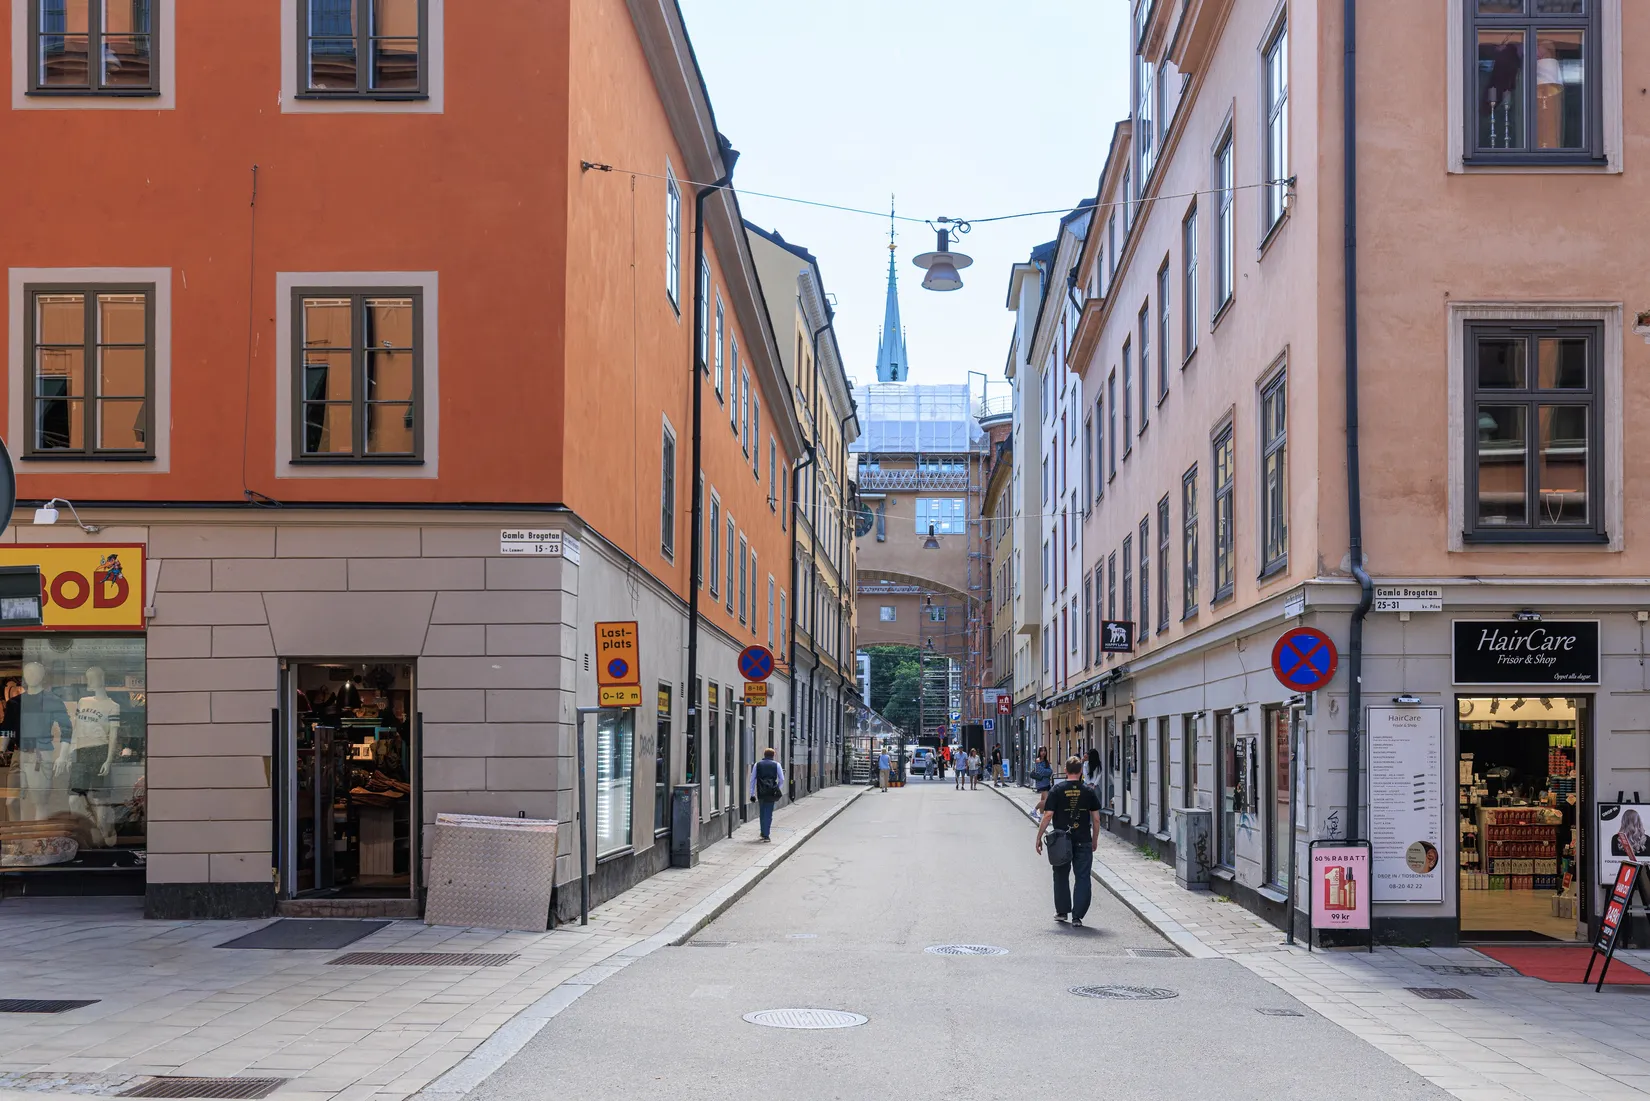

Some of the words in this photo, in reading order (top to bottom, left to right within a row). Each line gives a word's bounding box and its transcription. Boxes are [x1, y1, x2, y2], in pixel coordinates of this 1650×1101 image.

[502, 531, 524, 539] Gamla
[528, 531, 560, 541] Brogatan
[40, 570, 129, 609] OD
[1377, 588, 1401, 597] Gamla
[1403, 588, 1438, 598] Brogatan
[1377, 601, 1399, 609] 25-31
[601, 628, 632, 638] Last-
[1477, 628, 1577, 651] HairCare
[602, 639, 632, 651] plats
[1497, 653, 1525, 665] Frisör
[1524, 655, 1533, 664] &
[1533, 653, 1557, 667] Shop
[602, 692, 625, 700] 0-12
